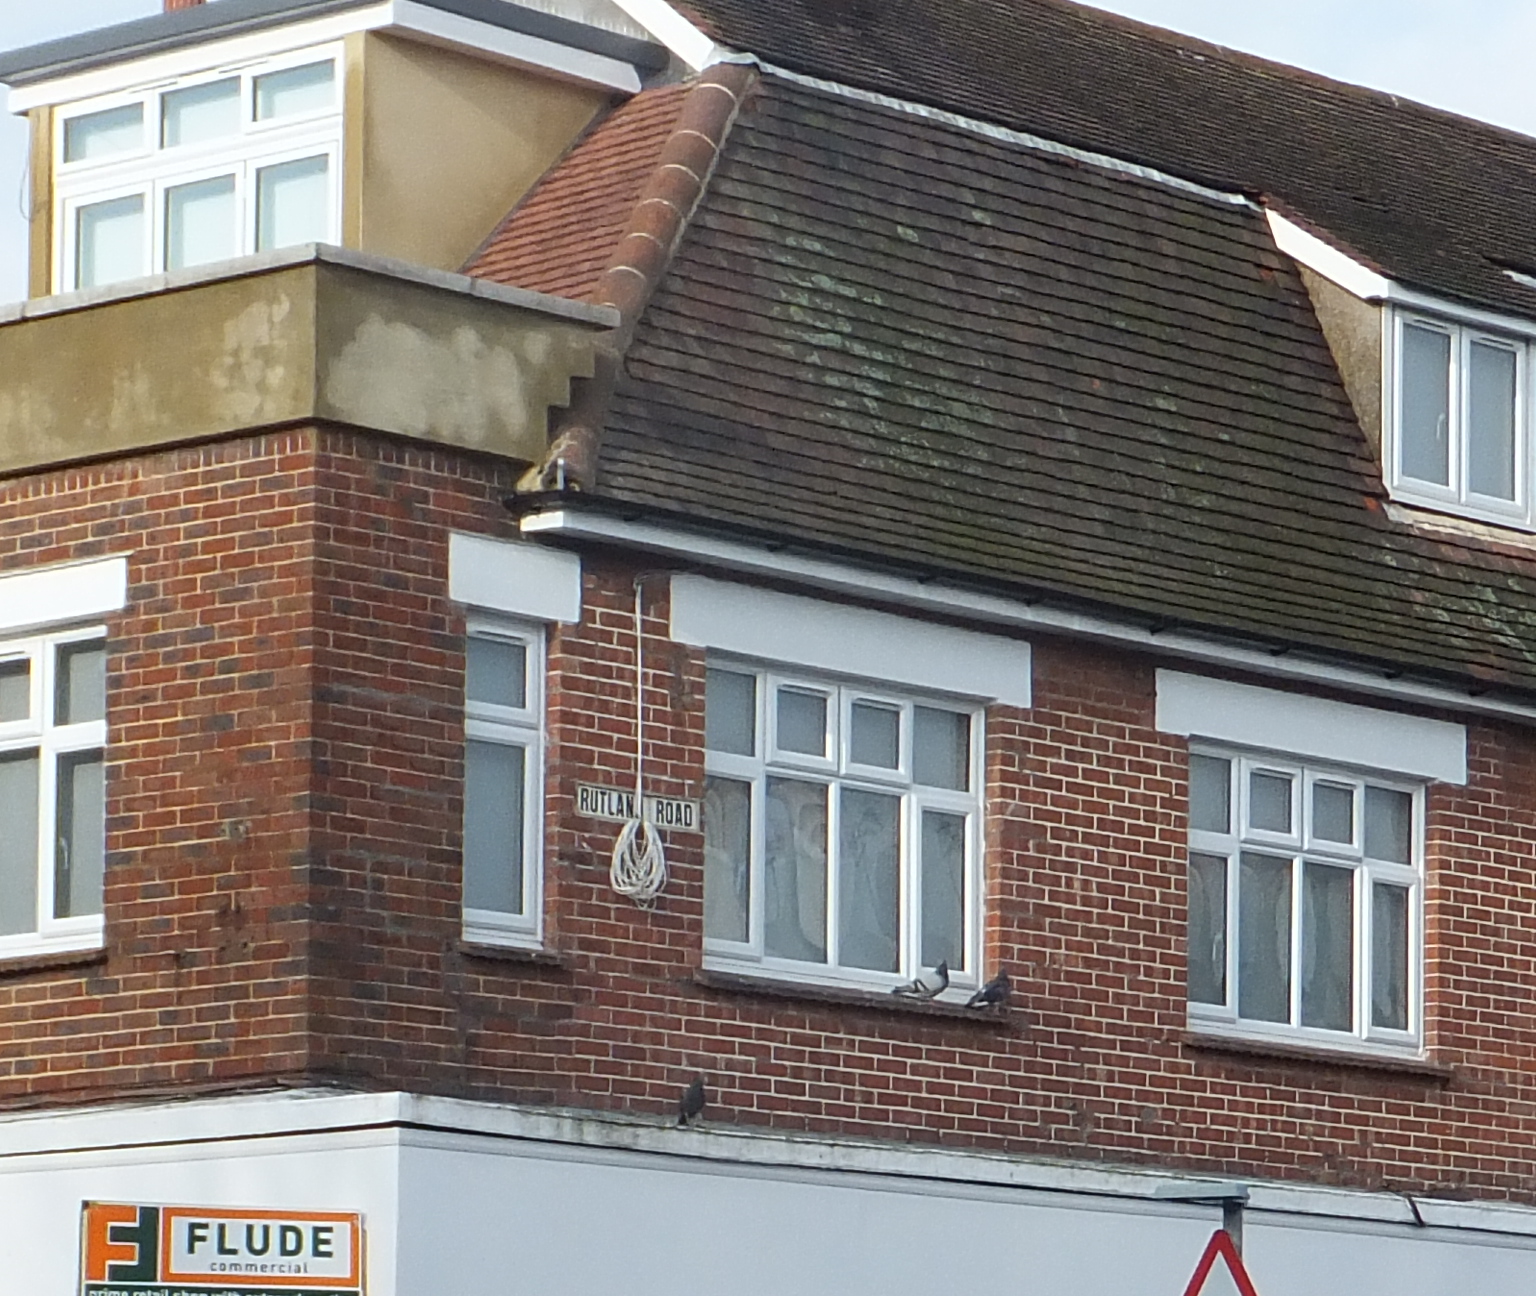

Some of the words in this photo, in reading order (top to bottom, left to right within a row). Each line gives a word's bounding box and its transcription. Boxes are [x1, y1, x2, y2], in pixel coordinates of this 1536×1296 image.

[580, 787, 641, 820] RUTLAN
[656, 800, 693, 828] ROAD
[187, 1222, 333, 1258] FLUDE
[210, 1261, 308, 1275] commercial
